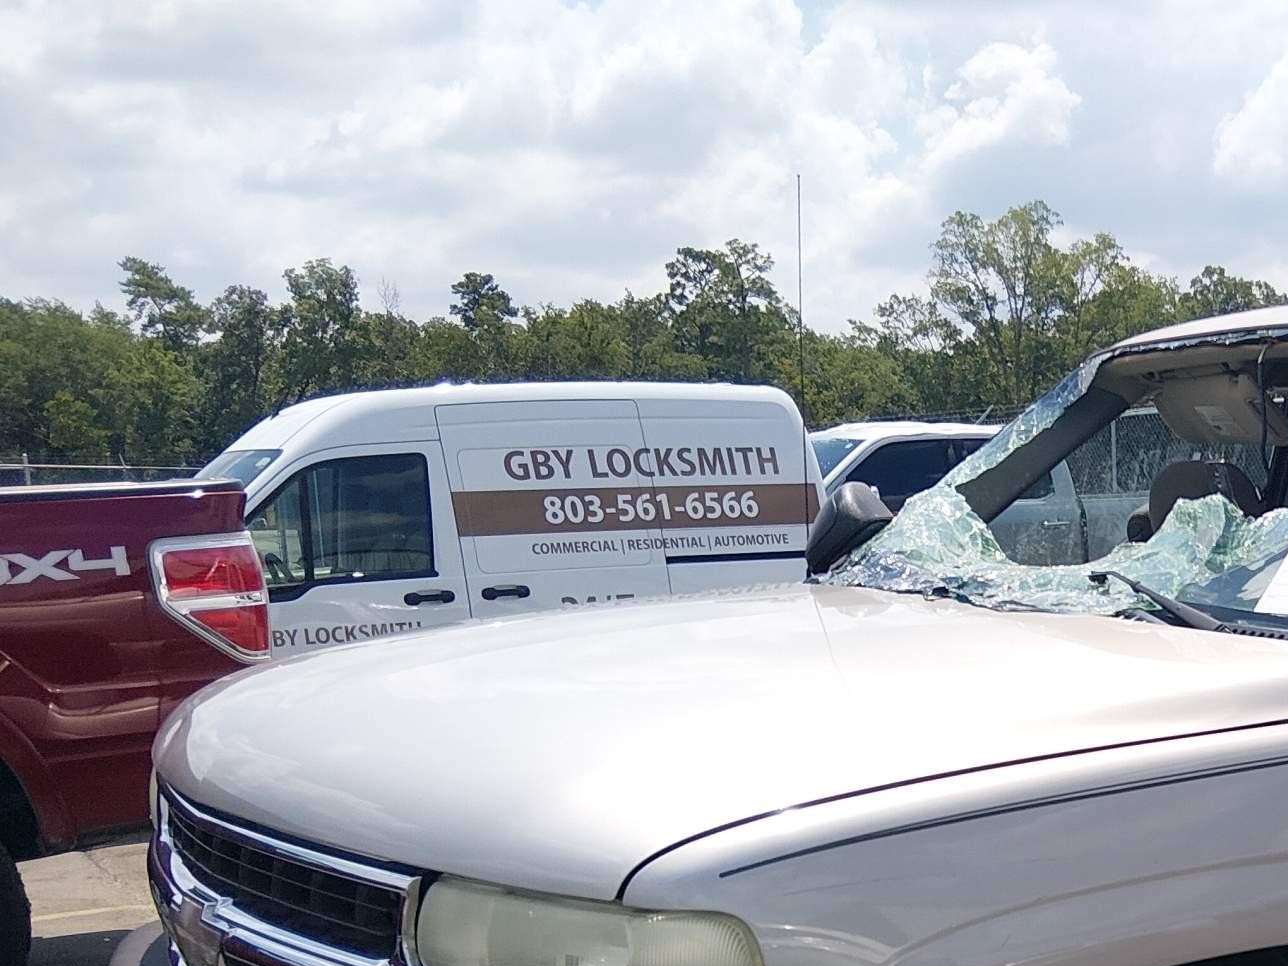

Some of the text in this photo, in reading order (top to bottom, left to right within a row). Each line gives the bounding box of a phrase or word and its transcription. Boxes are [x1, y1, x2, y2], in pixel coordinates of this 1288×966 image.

[503, 447, 780, 481] GBY LOCKSMITH
[543, 490, 760, 525] 803-561-6566
[532, 539, 619, 556] COMMERCIAL
[627, 536, 706, 551] RESIDENTIAL
[714, 533, 789, 547] AUTOMOTIVE
[272, 629, 298, 647] BY
